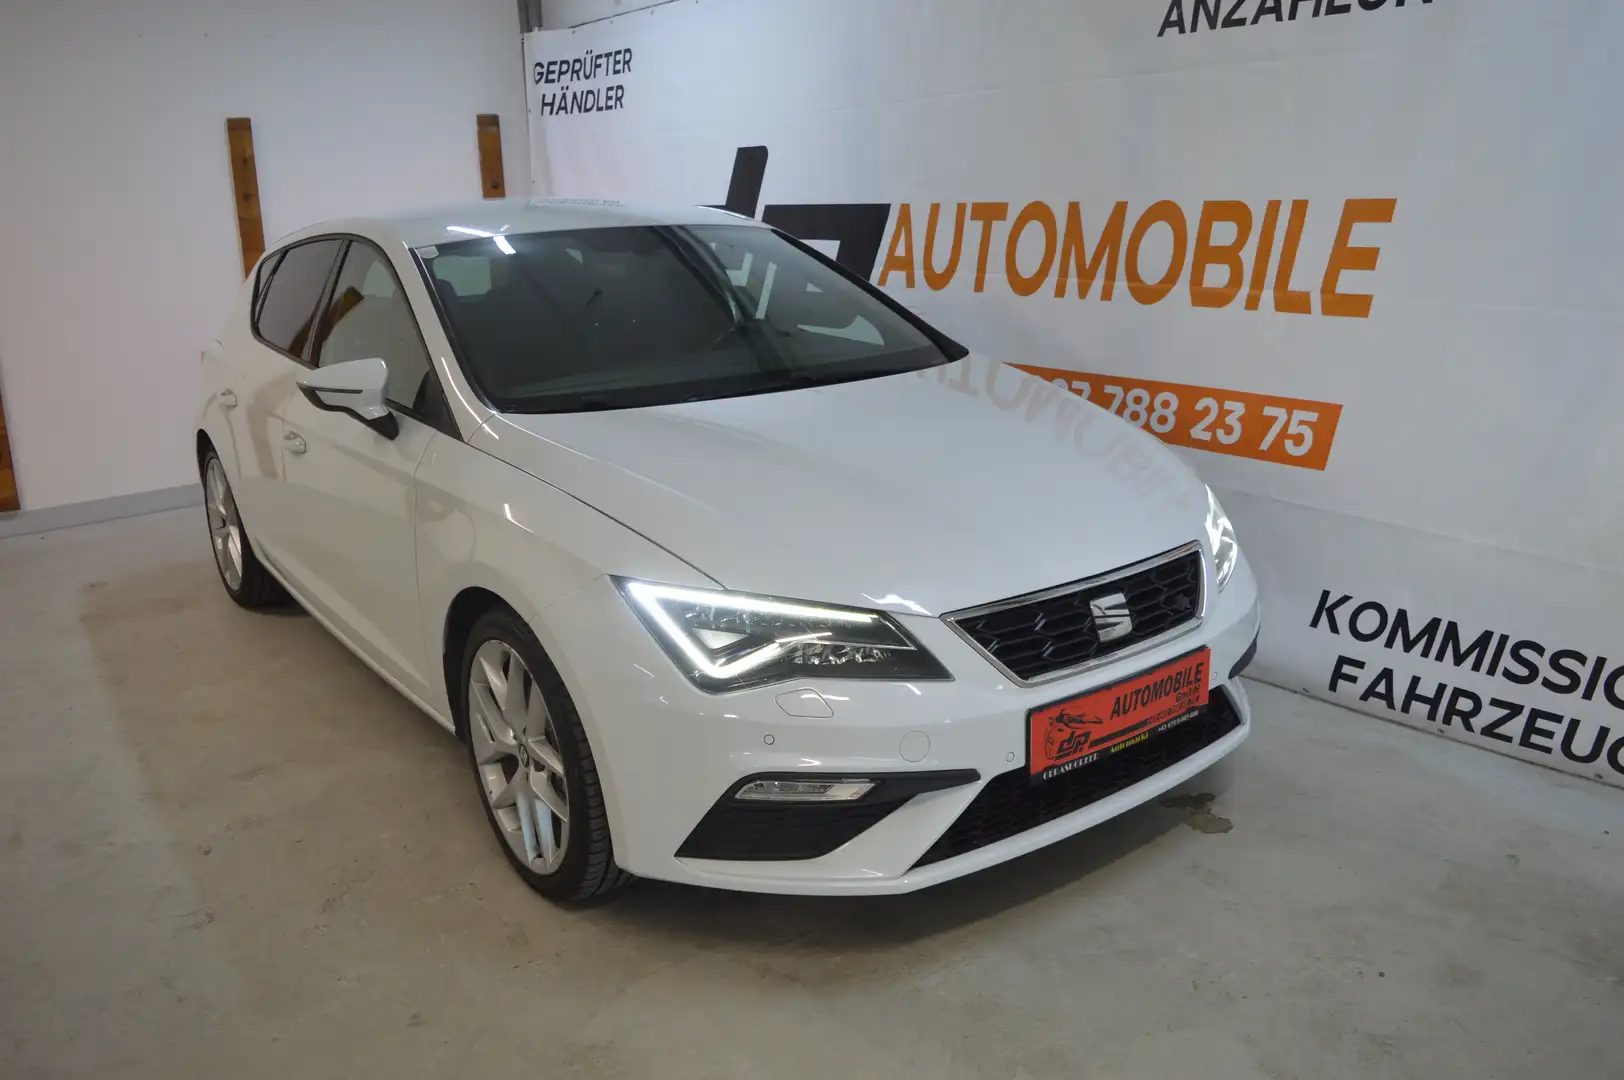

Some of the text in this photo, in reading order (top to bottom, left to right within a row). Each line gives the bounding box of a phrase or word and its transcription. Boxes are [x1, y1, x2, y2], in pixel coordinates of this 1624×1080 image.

[1156, 0, 1434, 38] ANZAH
[533, 48, 633, 85] GEPRÜFTER
[541, 85, 625, 116] HÄNDLER
[877, 198, 1398, 319] AUTOMOBILE
[1102, 384, 1179, 434] 788
[1190, 397, 1246, 445] 23
[1258, 405, 1319, 456] 75
[1109, 662, 1204, 720] AUTOMOBILE
